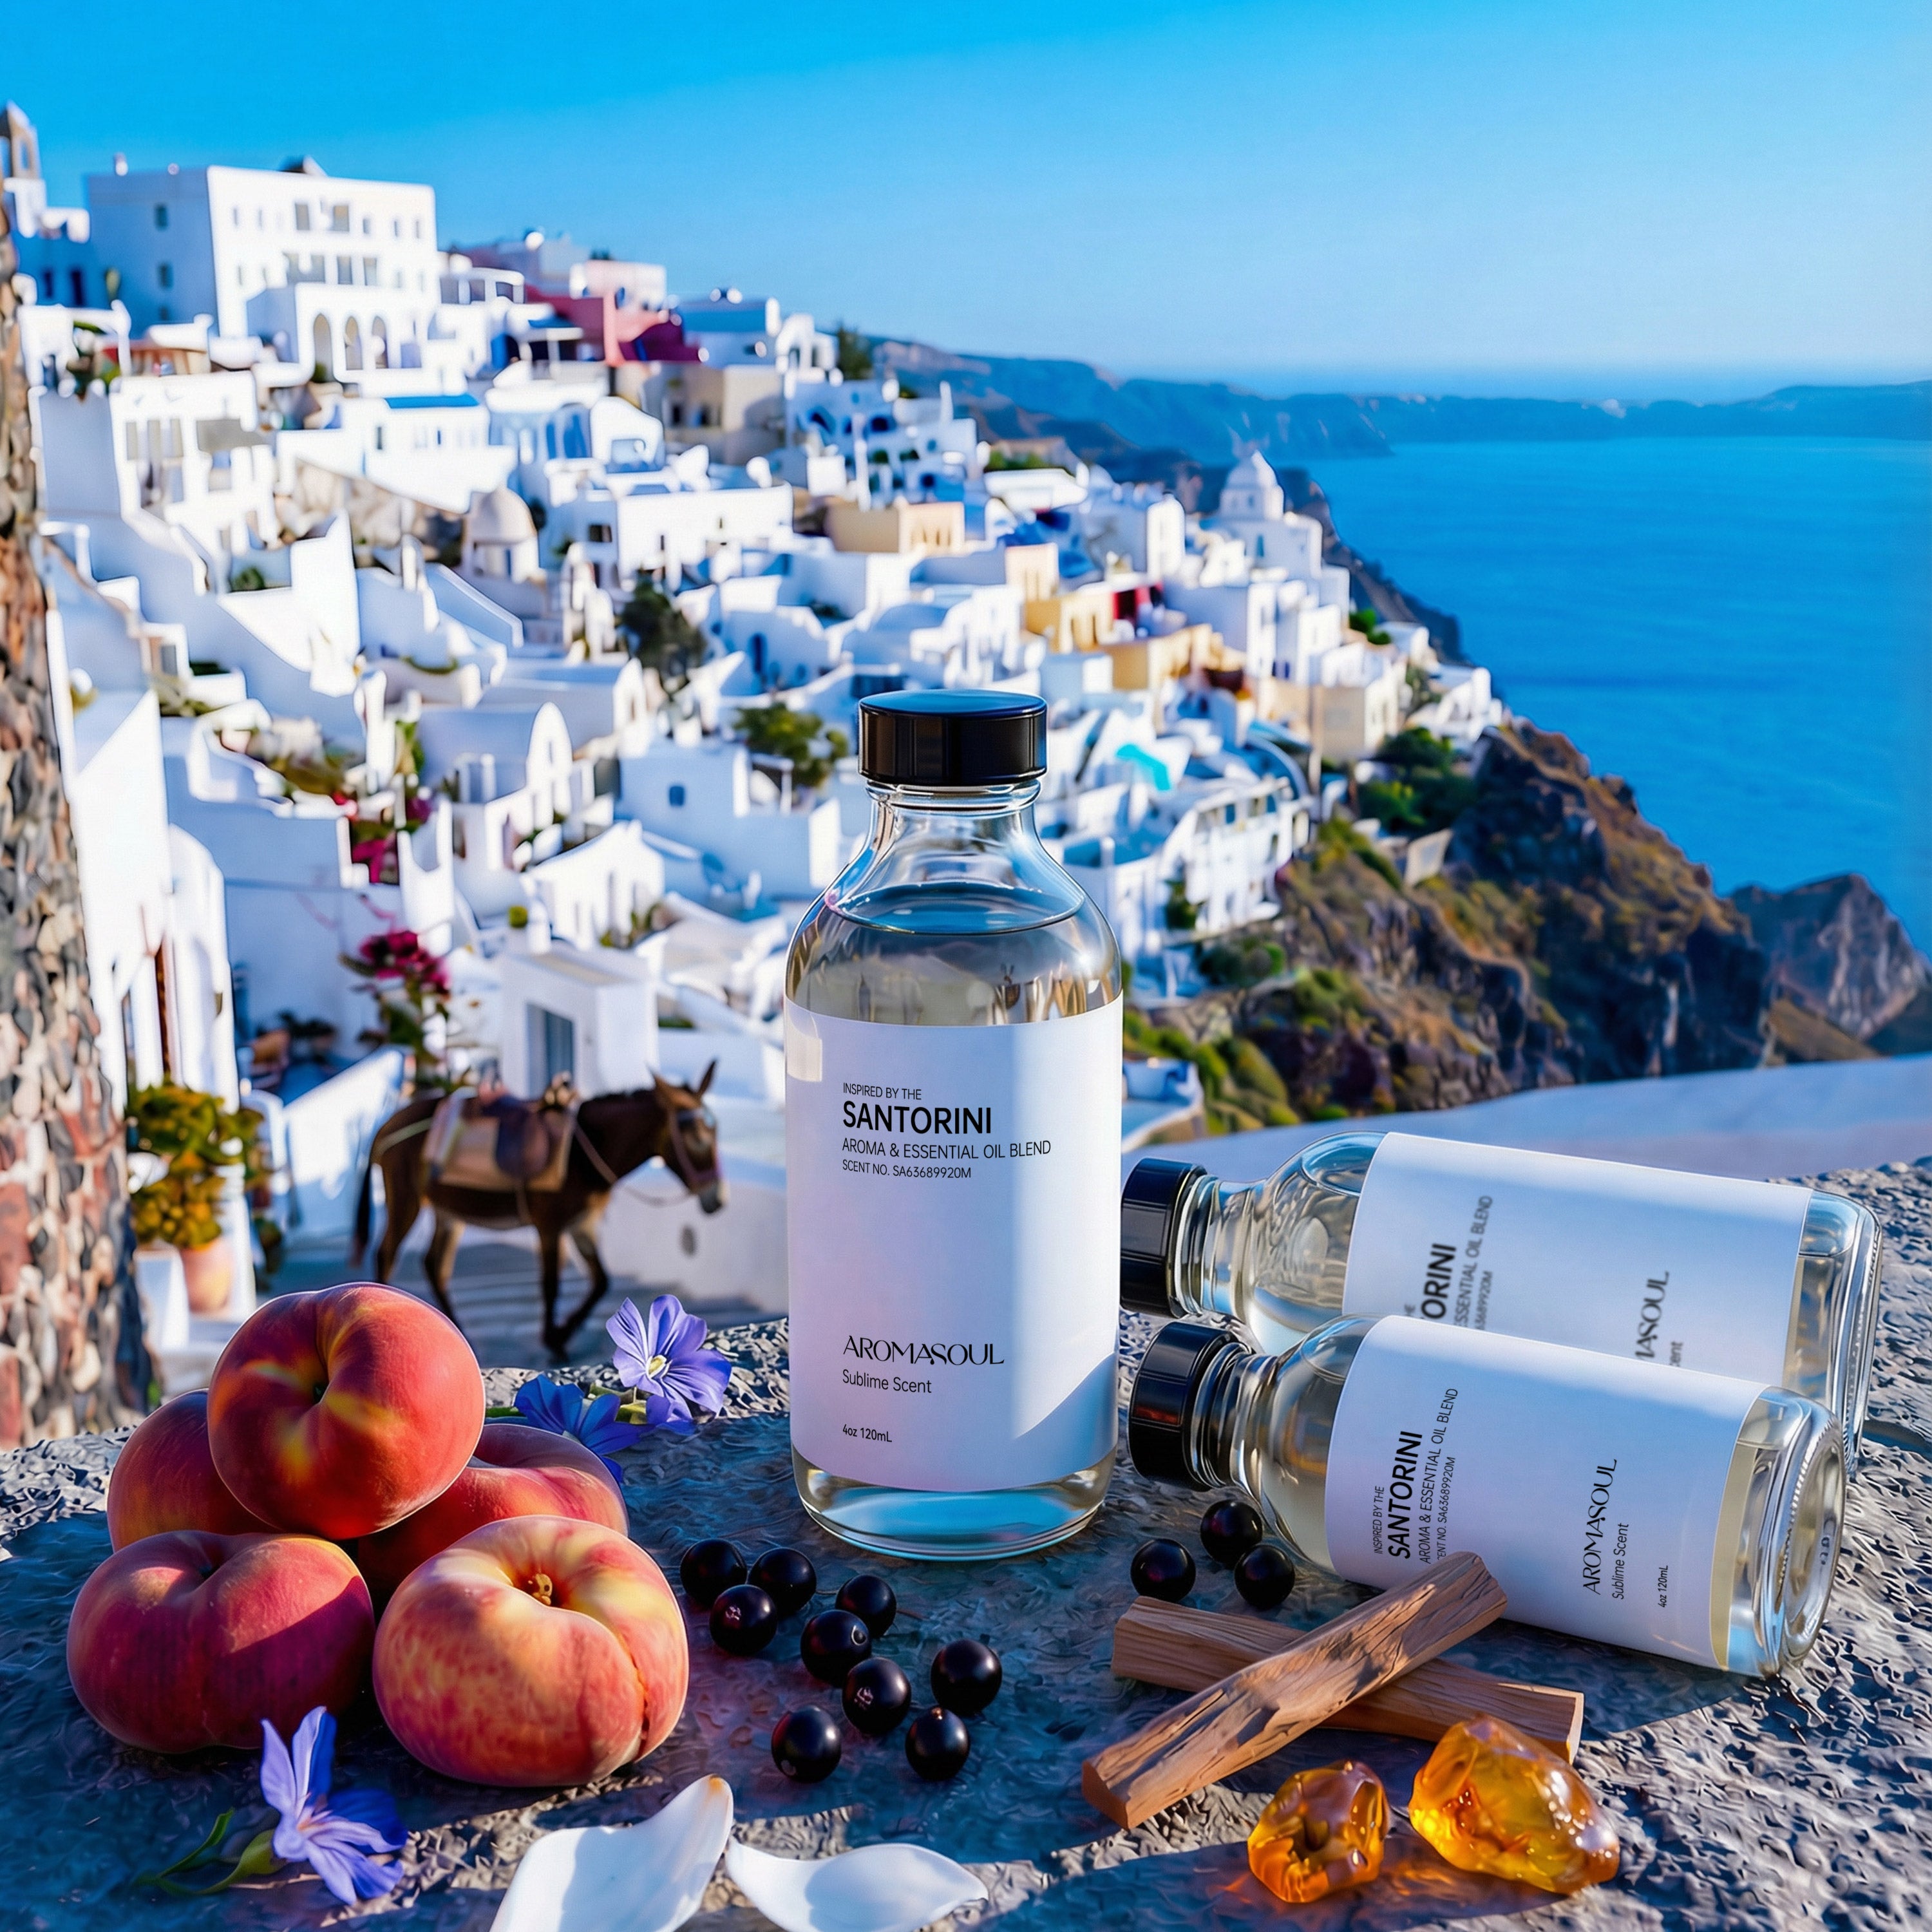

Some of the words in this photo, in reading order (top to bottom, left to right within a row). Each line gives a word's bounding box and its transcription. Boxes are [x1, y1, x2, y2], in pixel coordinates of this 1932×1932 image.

[843, 1082, 883, 1097] INSPIRED
[886, 1087, 899, 1099] BY
[902, 1088, 922, 1100] THE
[843, 1100, 991, 1134] SANTORINI
[842, 1137, 886, 1157] AROMA
[889, 1143, 900, 1157] &
[904, 1144, 979, 1159] ESSENTIAL
[983, 1144, 1005, 1159] OIL
[1010, 1140, 1051, 1157] BLEND
[842, 1159, 871, 1173] SCENT
[873, 1163, 890, 1176] NO.
[893, 1165, 971, 1179] SA63689920M
[1470, 1195, 1493, 1235] BLEND
[1465, 1238, 1483, 1258] OIL
[1420, 1243, 1457, 1320] ORINI
[1635, 1271, 1670, 1359] ASOUL
[843, 1335, 1005, 1366] AROMASOUL
[842, 1368, 889, 1390] Sublime
[893, 1377, 933, 1394] Scent
[1436, 1388, 1458, 1423] BLEND
[842, 1424, 858, 1437] 4oz
[860, 1428, 893, 1443] 120mL
[1431, 1426, 1446, 1444] OIL
[1420, 1448, 1441, 1511] ESSENTIAL
[1437, 1457, 1455, 1524] SA63689920M
[1374, 1486, 1384, 1503] THE
[1387, 1431, 1423, 1559] SANTORINI
[1373, 1504, 1382, 1517] BY
[1419, 1514, 1431, 1523] &
[1372, 1519, 1383, 1555] INSPIRED
[1437, 1526, 1446, 1541] NO.
[1583, 1459, 1617, 1595] AROMASOUL
[1613, 1522, 1629, 1557] Scent
[1419, 1526, 1431, 1564] AROMA
[1437, 1541, 1446, 1560] ENT
[1612, 1559, 1625, 1600] Sublime
[1658, 1565, 1669, 1592] 120mL
[1658, 1594, 1667, 1608] 4oz
